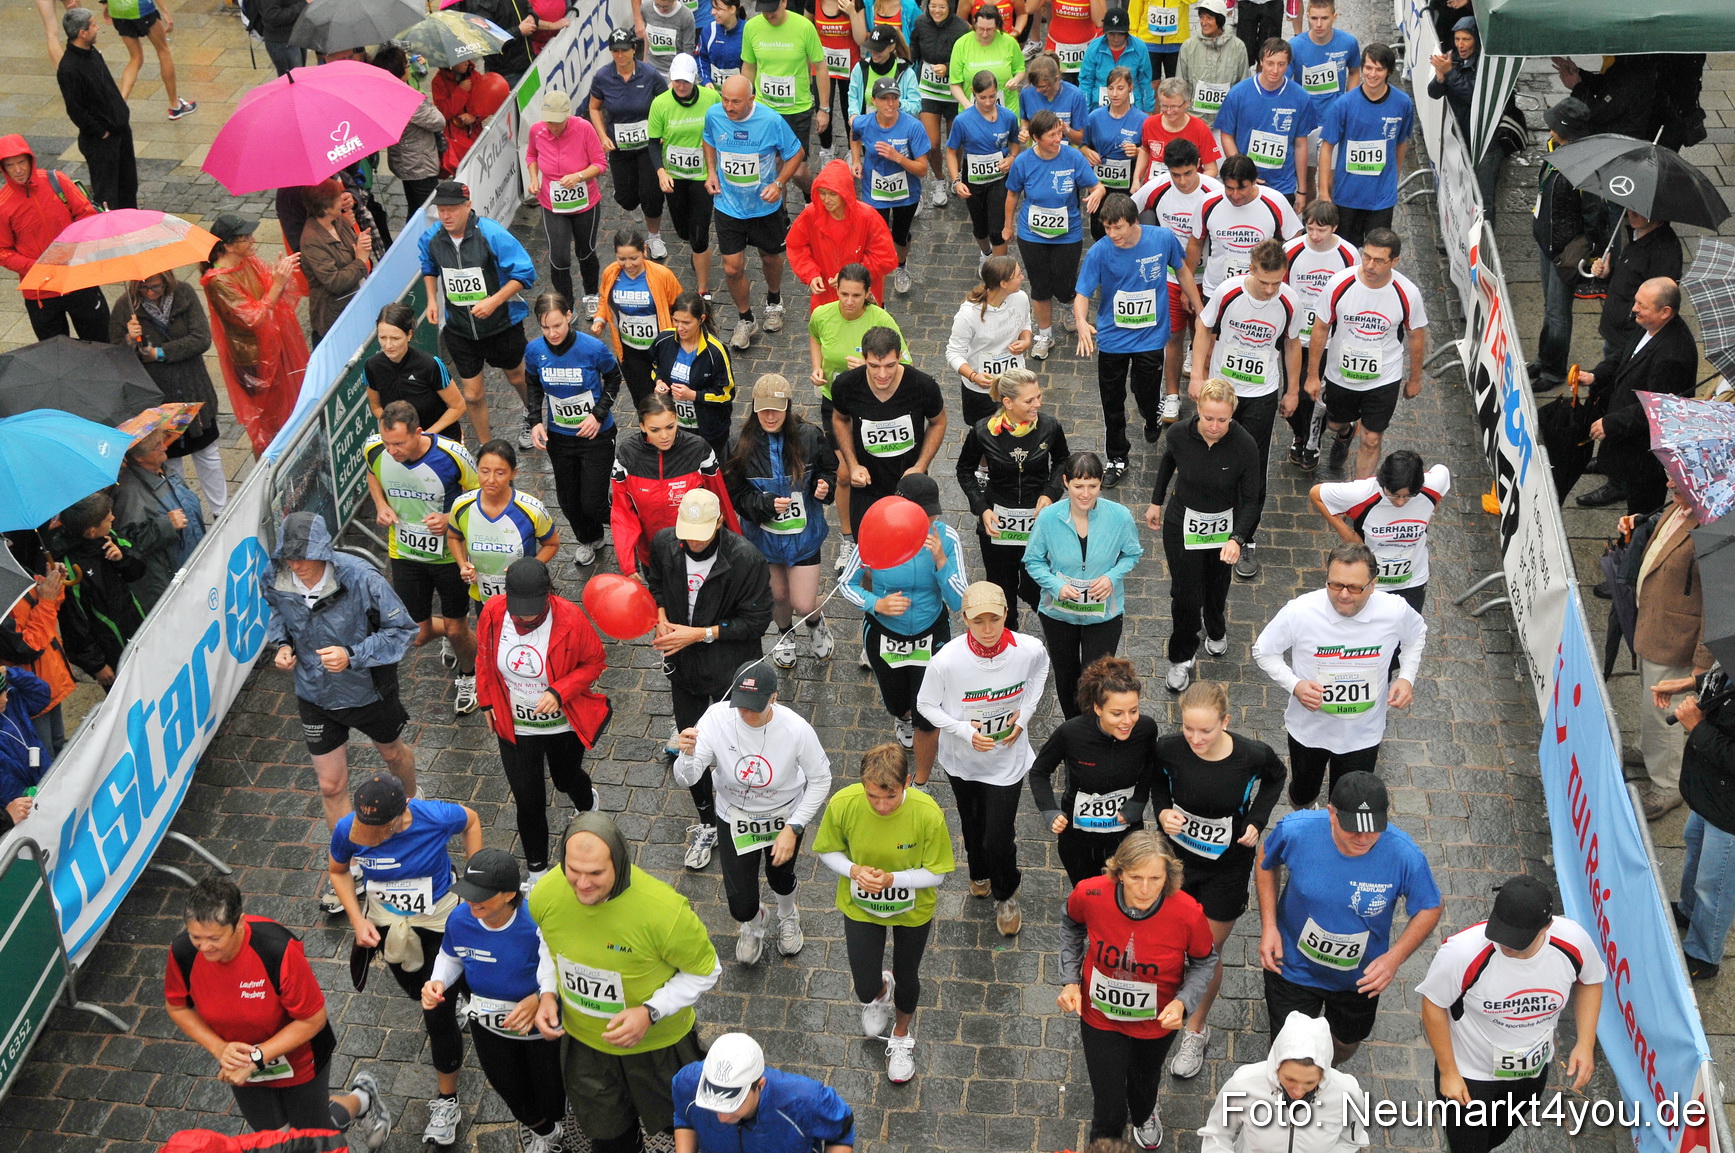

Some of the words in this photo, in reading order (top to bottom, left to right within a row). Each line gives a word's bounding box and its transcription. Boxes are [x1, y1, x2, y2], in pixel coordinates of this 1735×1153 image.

[1150, 13, 1176, 25] 3418
[824, 56, 847, 68] 047
[1059, 50, 1085, 61] 5100
[1305, 70, 1335, 85] 5219
[763, 83, 791, 96] 5161
[1198, 89, 1226, 102] 5085
[618, 130, 648, 144] 5154
[1252, 140, 1285, 157] 5115
[670, 154, 700, 167] 5146
[1350, 150, 1383, 162] 5019
[724, 161, 756, 175] 5217
[971, 160, 1001, 175] 5055
[1097, 167, 1127, 179] 5054
[875, 179, 903, 192] 5207
[553, 187, 585, 202] 5228
[1032, 214, 1065, 228] 5222
[1216, 229, 1254, 237] GERHART
[448, 277, 482, 293] 5028
[612, 290, 650, 300] HUBER
[1118, 299, 1153, 315] 5077
[1344, 314, 1382, 324] GERHART
[622, 322, 653, 338] 5130
[1229, 319, 1268, 333] GERHART
[1360, 323, 1386, 332] JANIG
[1245, 330, 1272, 339] JANIG
[983, 357, 1018, 375] 5076
[1226, 355, 1264, 375] 5196
[1342, 354, 1378, 372] 5176
[541, 366, 582, 377] HUBER
[1231, 372, 1253, 382] Patrick
[1346, 371, 1369, 380] Richard
[555, 401, 594, 416] 5084
[337, 428, 354, 463] Fun
[355, 415, 363, 432] &
[867, 427, 909, 444] 5215
[387, 480, 418, 489] TEAM
[387, 489, 435, 501] BOCK
[997, 516, 1036, 532] 5212
[1188, 519, 1228, 536] 5213
[1371, 525, 1420, 534] GERHART
[399, 529, 438, 552] 5049
[474, 534, 499, 542] TEAM
[472, 542, 514, 553] BOCK
[1343, 646, 1381, 657] ITALIA
[1323, 682, 1370, 702] 5201
[1337, 705, 1357, 713] Hans
[1567, 752, 1592, 852] TUI
[737, 817, 786, 834] 5016
[1181, 818, 1227, 843] 2892
[751, 834, 773, 843] Tanja
[1183, 835, 1212, 852] Simone
[863, 903, 887, 912] Ulrike
[1307, 931, 1361, 958] 5078
[1317, 953, 1340, 966] Hans
[239, 979, 266, 989] Lauftreff
[564, 971, 618, 1002] 5074
[240, 991, 266, 1000] Parsberg
[1095, 982, 1150, 1009] 5007
[580, 997, 601, 1011] Ivica
[1483, 995, 1549, 1010] GERHART
[1513, 1003, 1557, 1015] JANIG
[1109, 1005, 1132, 1018] Erika
[1492, 1018, 1504, 1027] Das
[8, 1018, 33, 1059] 6352
[1501, 1040, 1551, 1071] 5168
